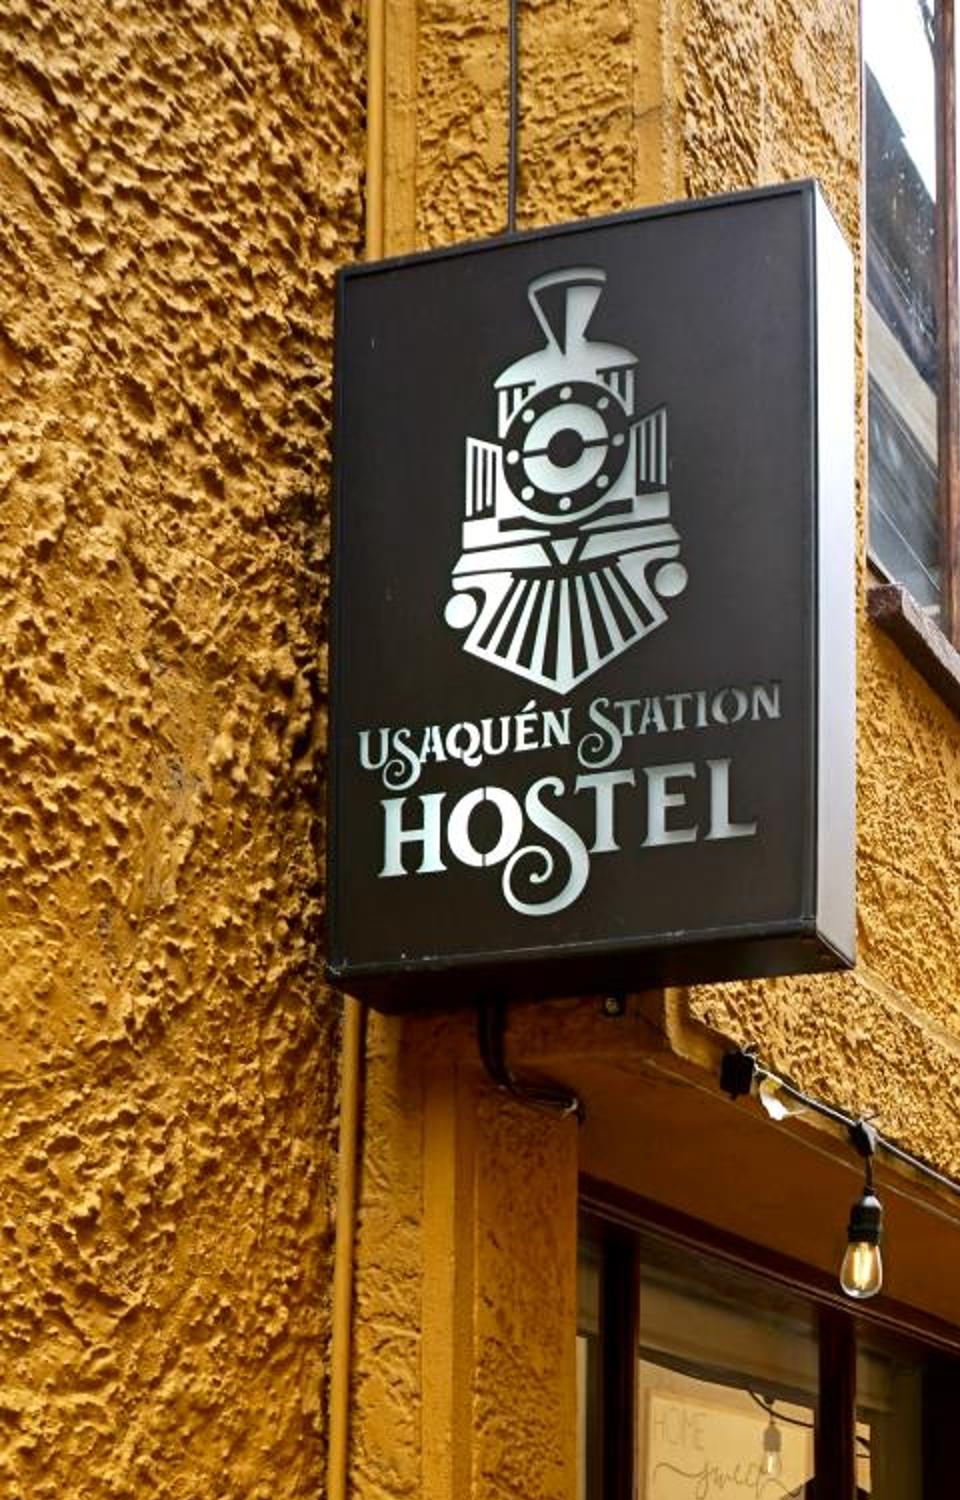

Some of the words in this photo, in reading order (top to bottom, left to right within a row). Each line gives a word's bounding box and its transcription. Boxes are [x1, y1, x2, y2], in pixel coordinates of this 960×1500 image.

[356, 700, 573, 791] USAQUÉN
[577, 684, 783, 769] STATION
[377, 757, 758, 917] HOSTEL
